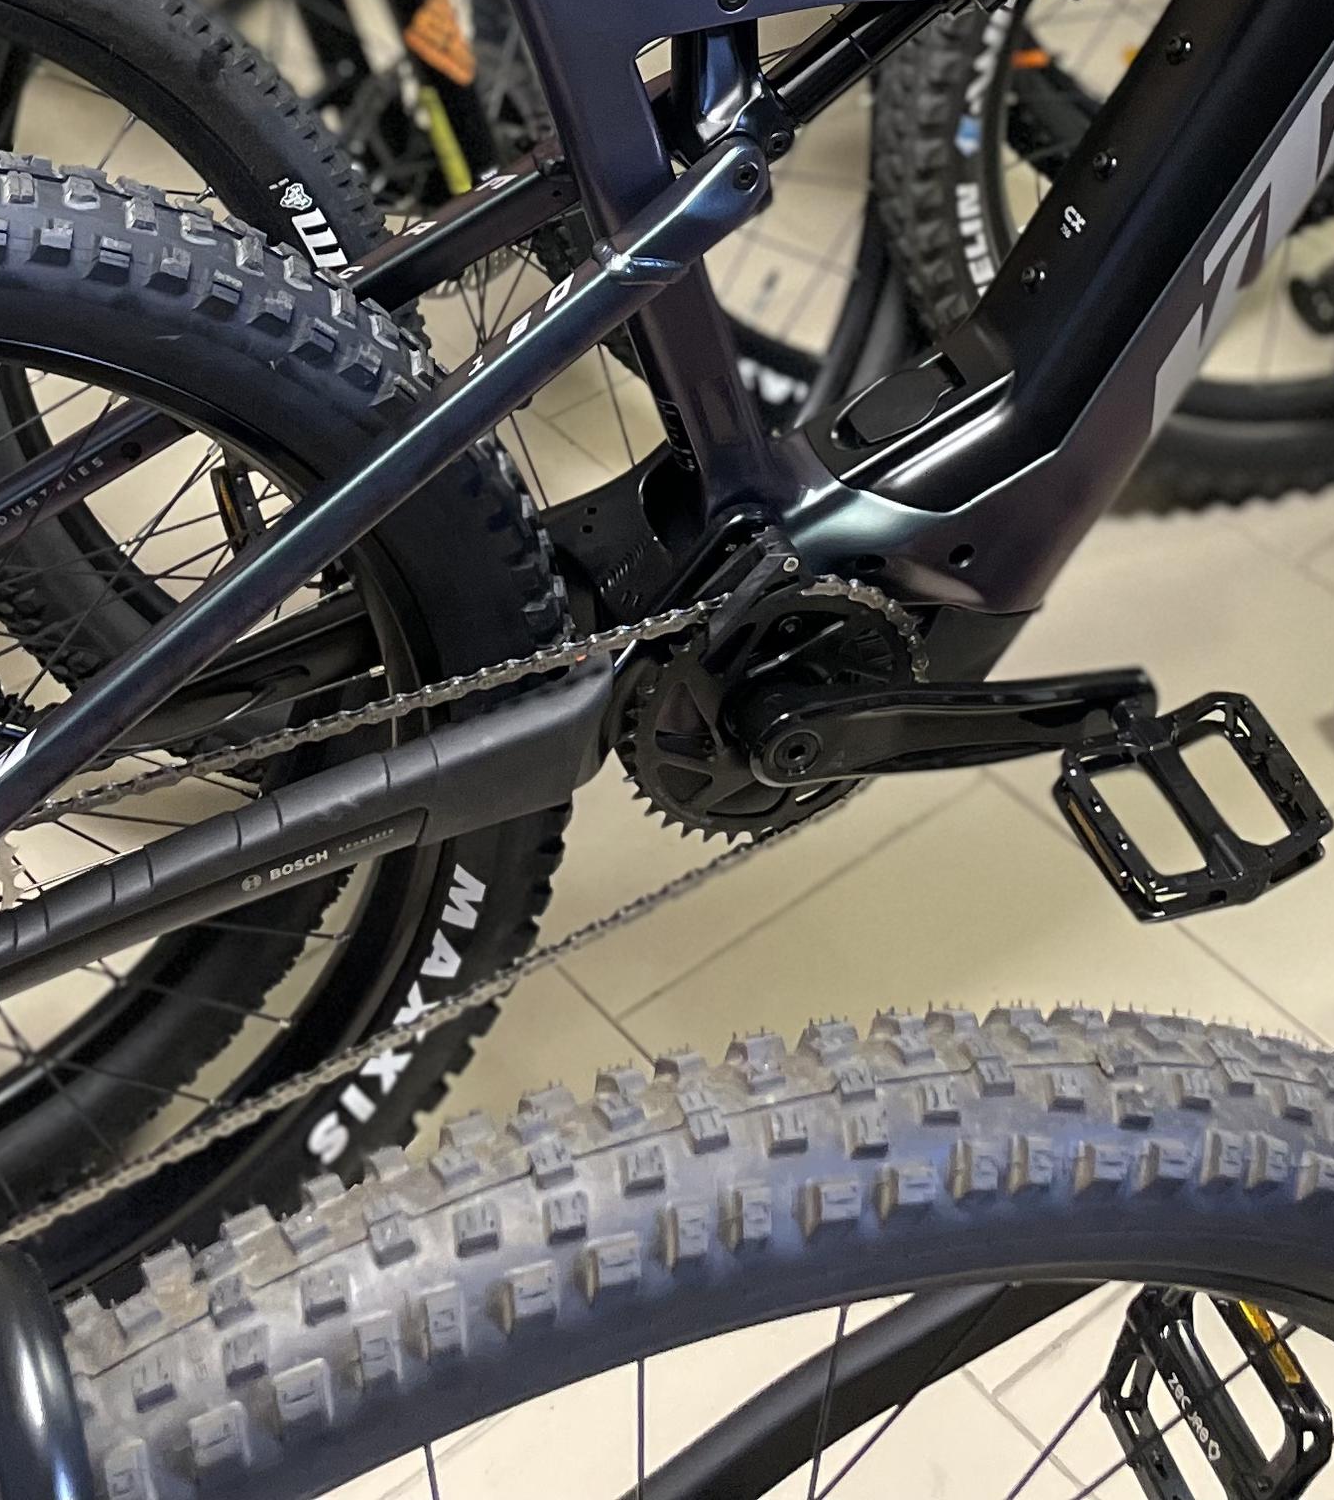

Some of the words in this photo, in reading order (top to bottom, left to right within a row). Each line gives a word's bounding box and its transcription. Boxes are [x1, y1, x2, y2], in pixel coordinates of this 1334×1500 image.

[1064, 205, 1087, 234] CX
[269, 849, 329, 882] BOSCH
[307, 863, 487, 1166] MAXXIS
